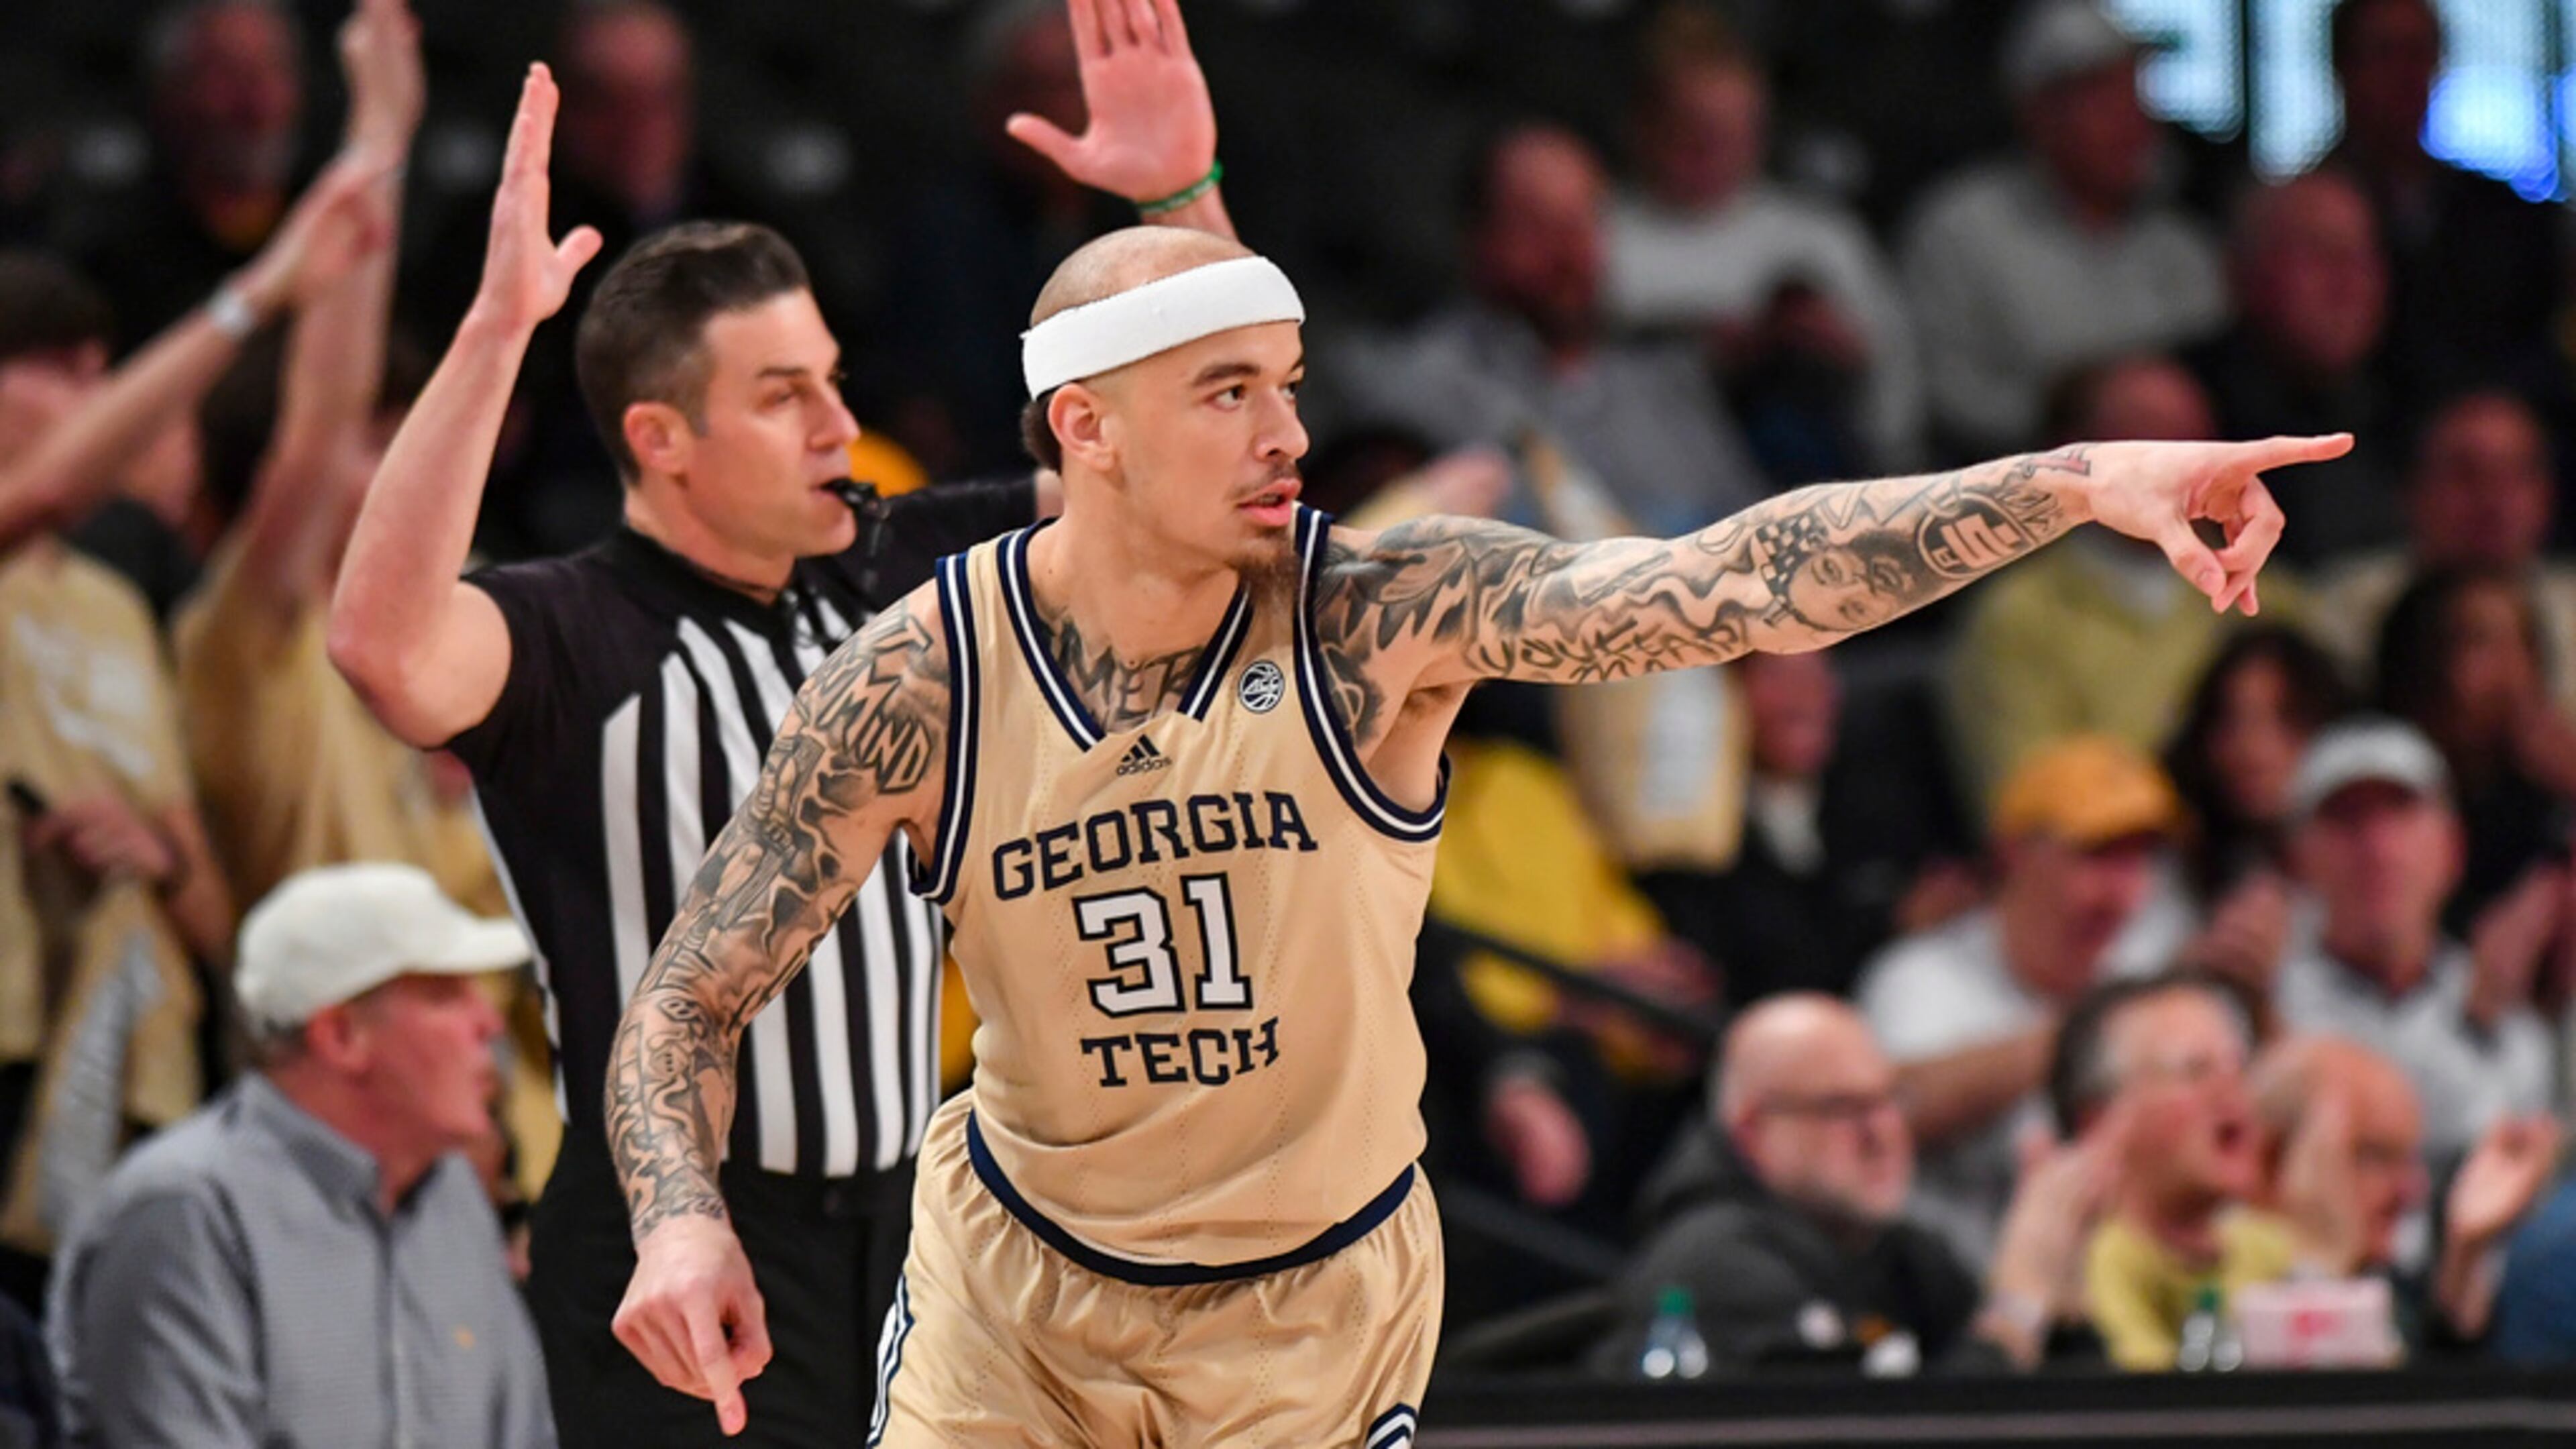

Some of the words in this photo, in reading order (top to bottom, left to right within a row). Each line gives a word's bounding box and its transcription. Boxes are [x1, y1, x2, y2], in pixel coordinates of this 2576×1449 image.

[1116, 757, 1173, 775] adidas
[992, 791, 1318, 901] GEORGIA
[1072, 871, 1254, 1019] 31
[1080, 1016, 1279, 1087] TECH
